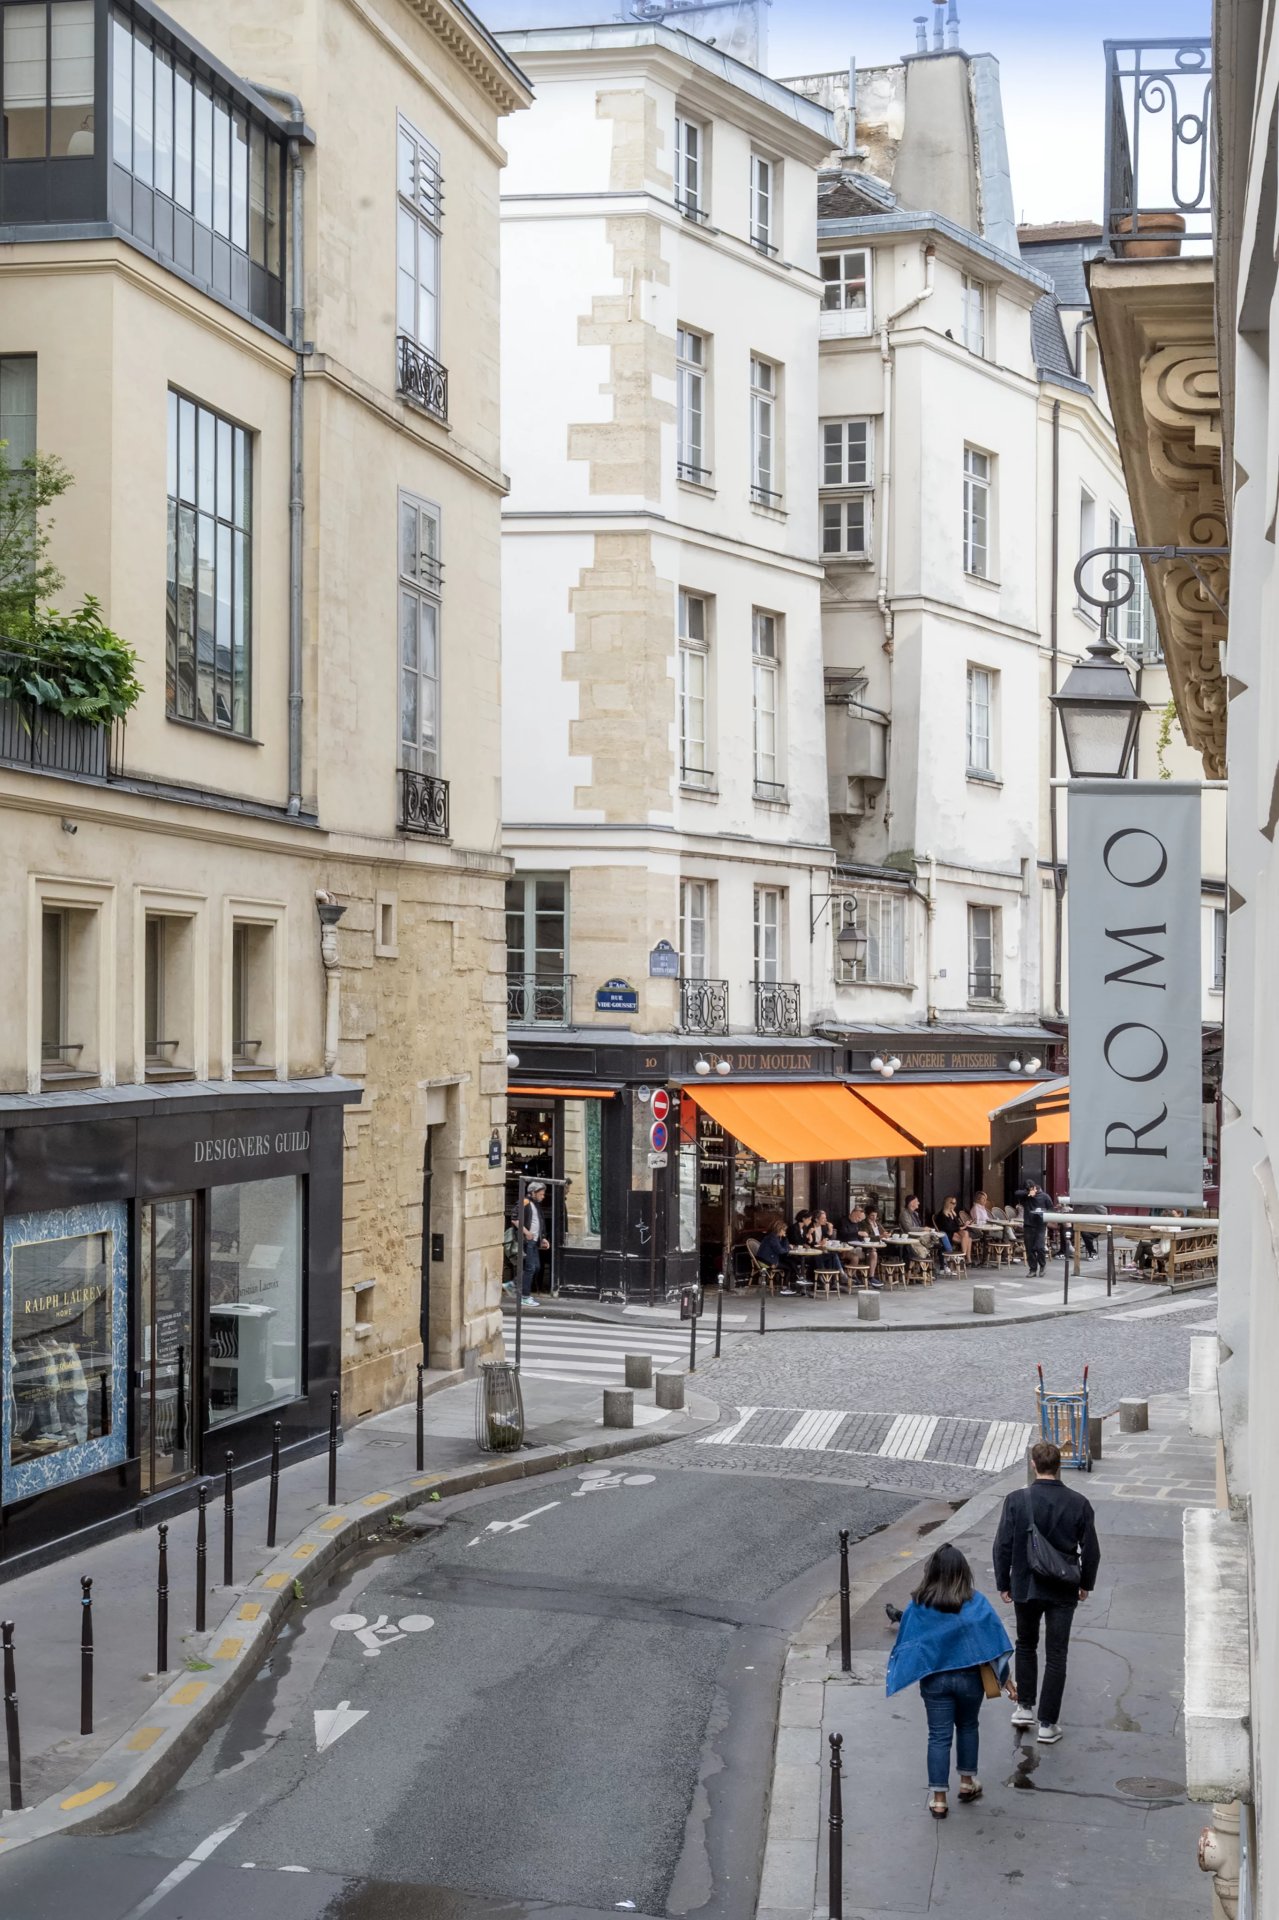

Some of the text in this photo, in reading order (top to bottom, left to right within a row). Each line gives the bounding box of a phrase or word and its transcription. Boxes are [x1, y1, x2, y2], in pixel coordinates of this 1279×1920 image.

[1103, 828, 1168, 1159] ROMO
[597, 1001, 636, 1009] VIDE-GOUSSET
[644, 1057, 657, 1068] 10
[738, 1054, 756, 1069] DU
[760, 1054, 812, 1069] MOULIN
[951, 1053, 997, 1068] PATISSERIE
[194, 1130, 310, 1163] DESIGNERS GUILD
[25, 1285, 102, 1314] RALPH LAUREN
